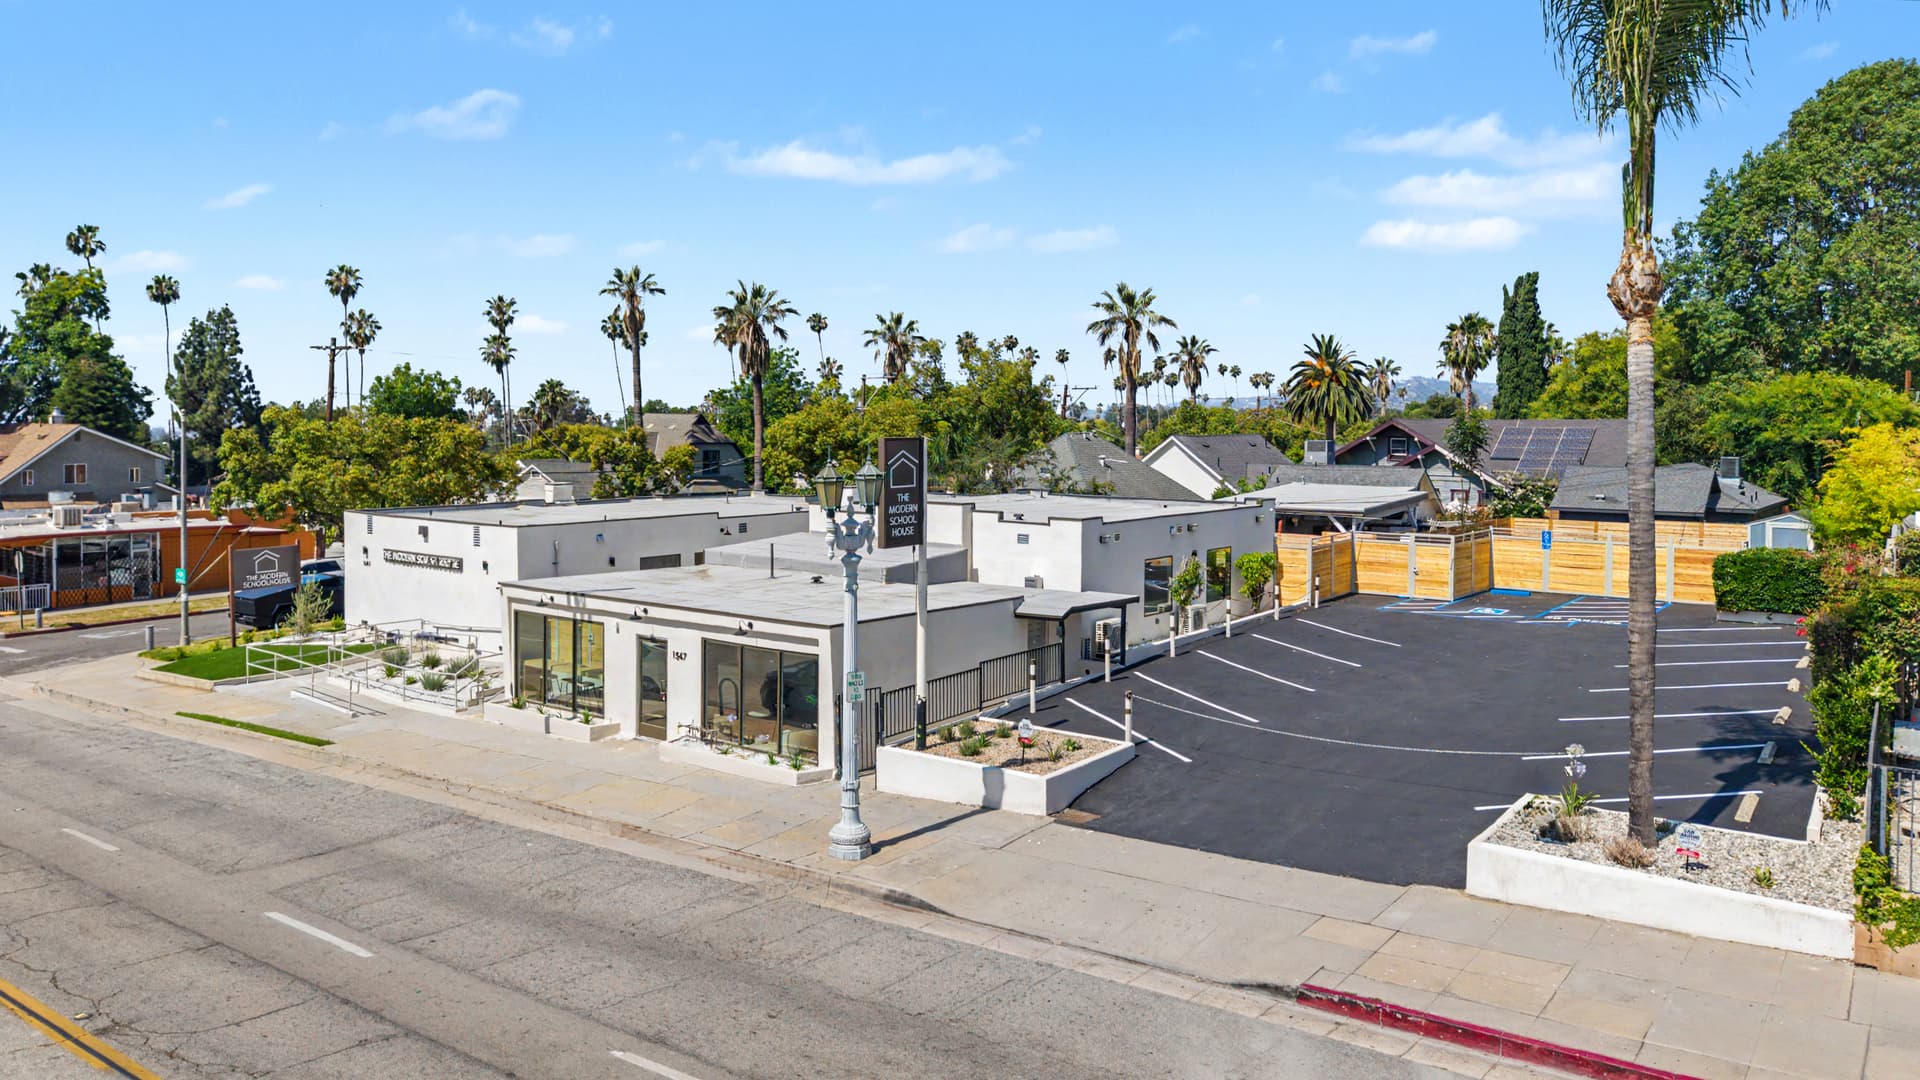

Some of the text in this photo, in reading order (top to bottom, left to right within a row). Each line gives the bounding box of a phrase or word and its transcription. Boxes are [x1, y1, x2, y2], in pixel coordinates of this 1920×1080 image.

[897, 493, 910, 502] THE
[888, 503, 919, 514] MODERN
[889, 515, 918, 526] SCHOOL
[892, 526, 915, 537] HOUSE
